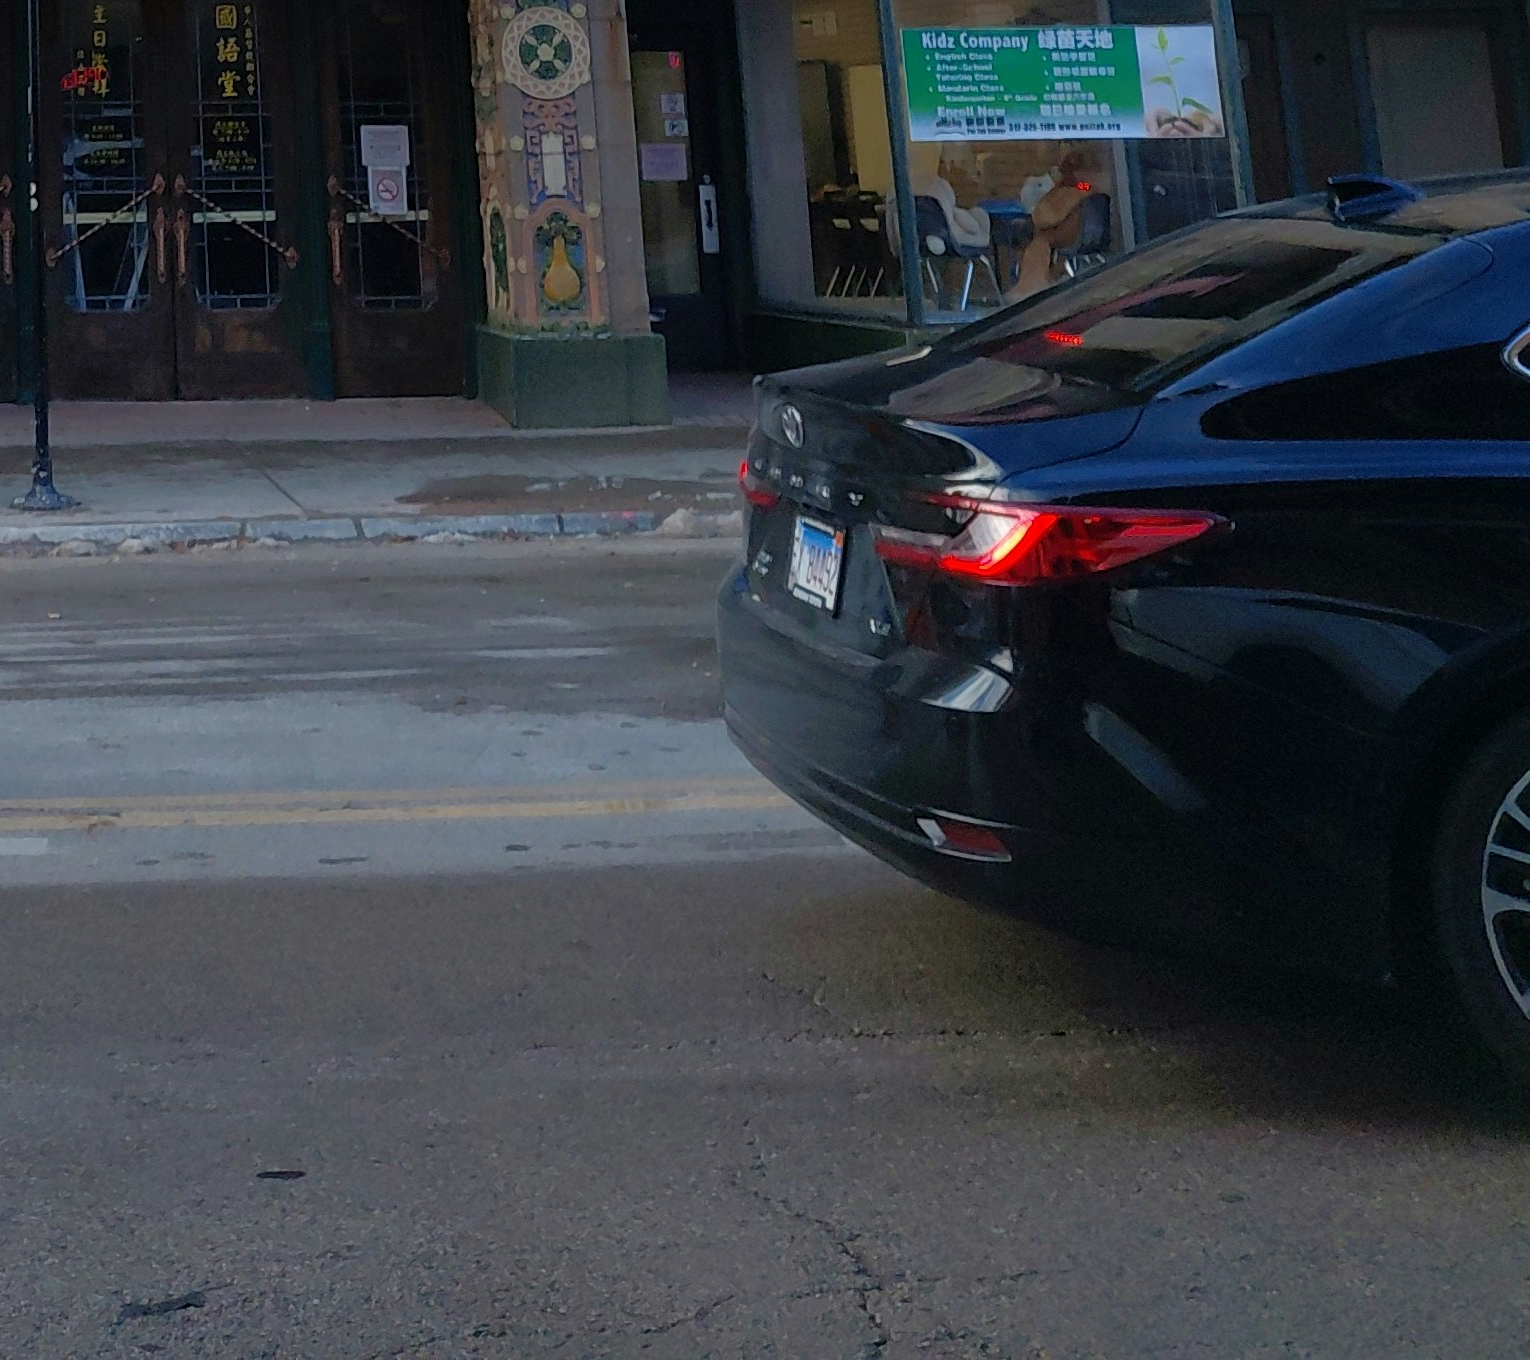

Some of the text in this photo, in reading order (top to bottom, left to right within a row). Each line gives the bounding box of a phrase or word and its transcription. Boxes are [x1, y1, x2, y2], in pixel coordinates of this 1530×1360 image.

[922, 32, 1028, 52] Kidz Company
[214, 4, 242, 98] 國語堂
[934, 52, 994, 62] English Class
[938, 84, 1005, 92] Mandarin Class
[937, 106, 1006, 117] Enroll Now
